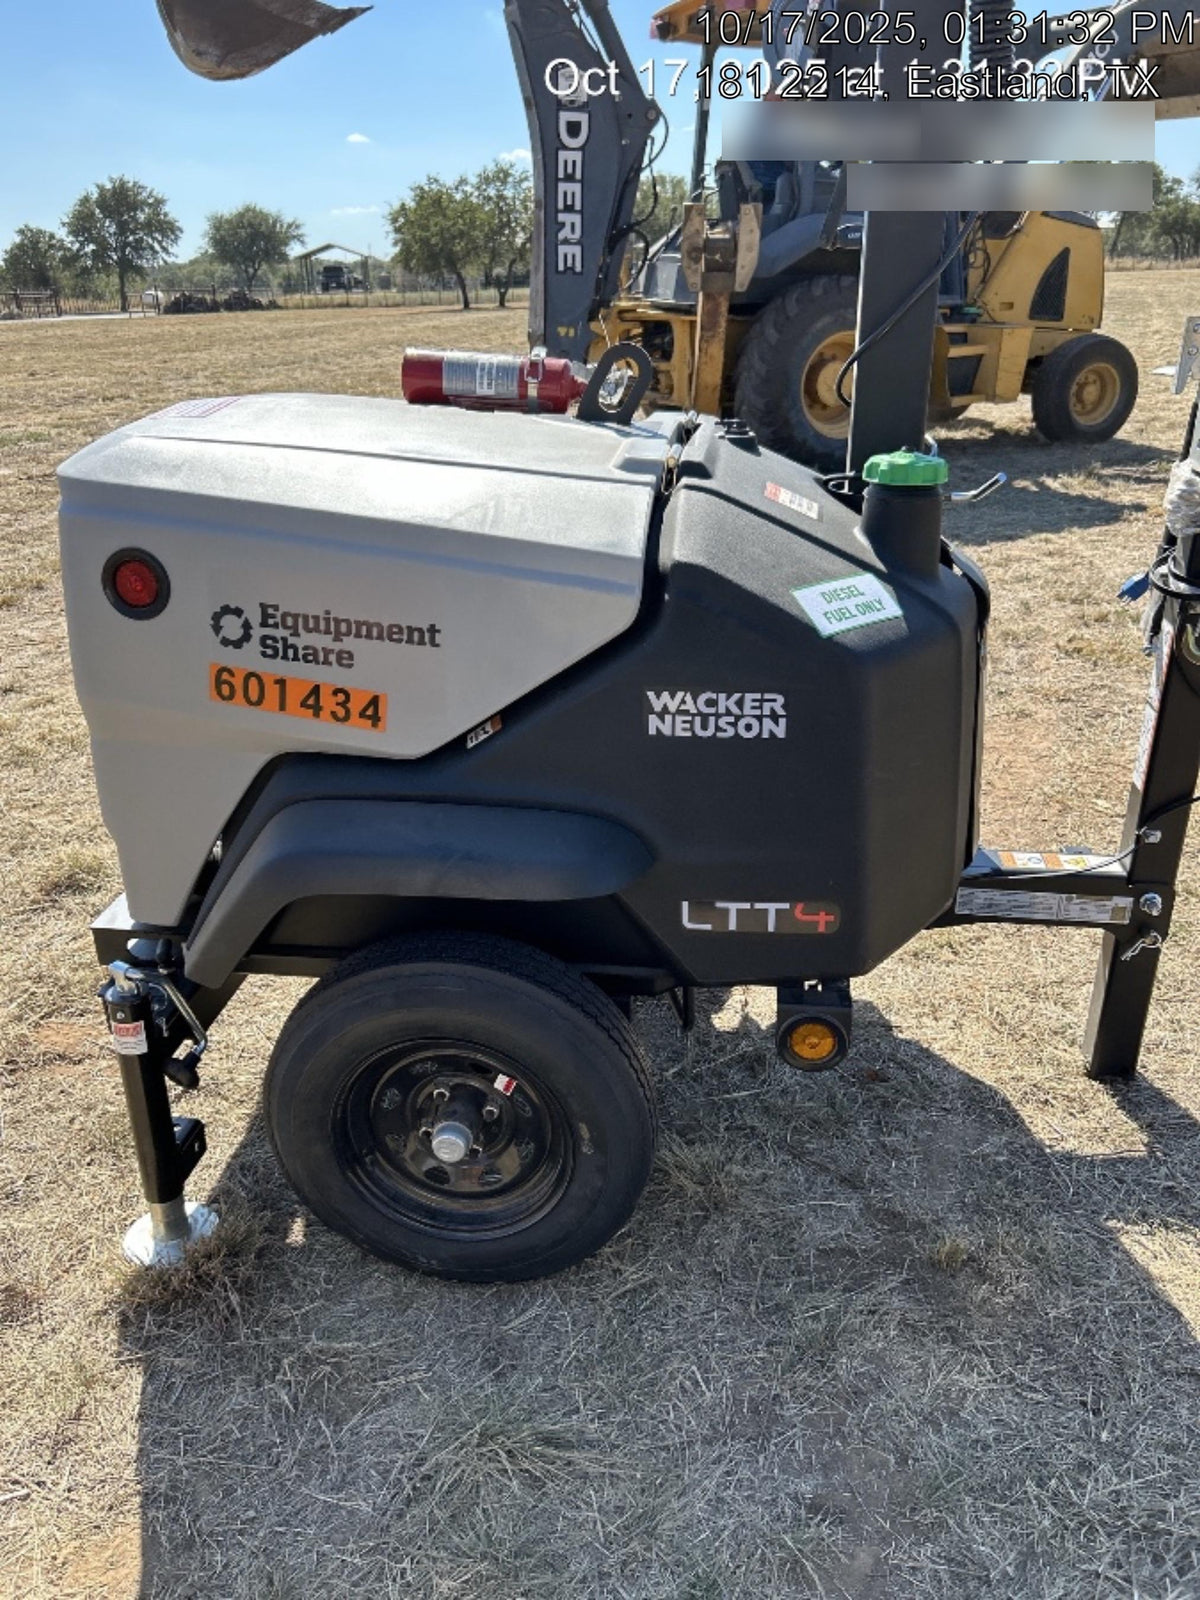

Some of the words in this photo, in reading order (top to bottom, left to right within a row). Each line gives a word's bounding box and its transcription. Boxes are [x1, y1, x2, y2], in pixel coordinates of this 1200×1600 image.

[557, 110, 590, 273] DEERE
[819, 584, 866, 605] DIESEL
[258, 602, 442, 648] Equipment
[822, 605, 858, 625] FUEL
[854, 597, 887, 616] ONLY
[259, 634, 355, 669] Share
[214, 665, 383, 730] 601434
[646, 690, 787, 716] WACKER
[648, 714, 787, 739] NEUSON
[681, 901, 835, 933] LTT4
